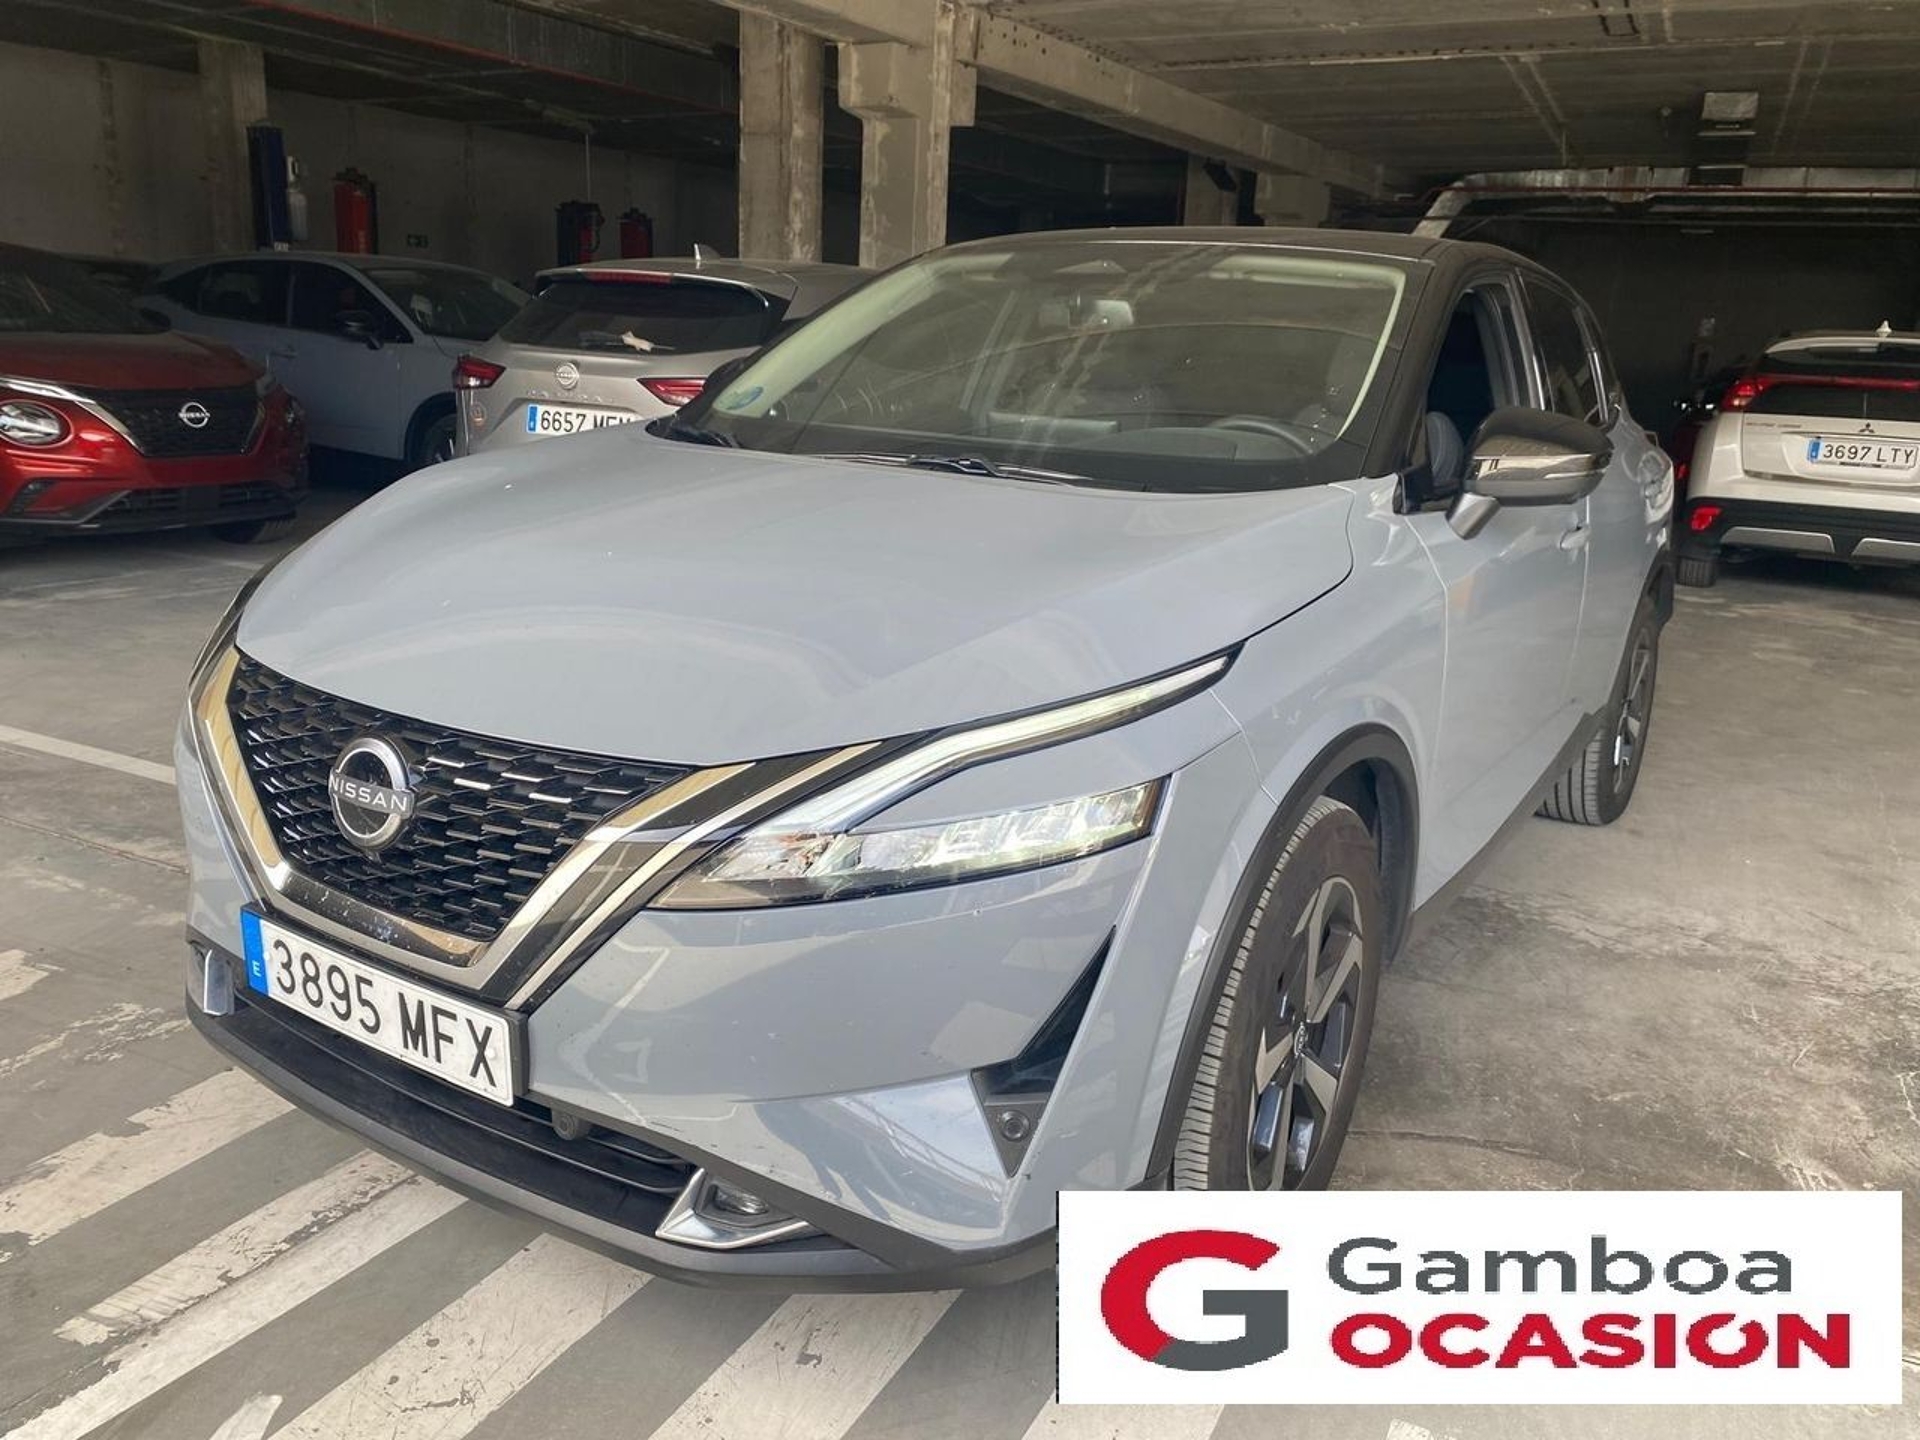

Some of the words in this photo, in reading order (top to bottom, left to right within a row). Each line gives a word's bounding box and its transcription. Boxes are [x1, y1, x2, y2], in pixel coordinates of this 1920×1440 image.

[541, 410, 587, 433] 6657
[1823, 444, 1873, 462] 3697
[1876, 447, 1915, 465] LTY
[329, 773, 408, 812] NISSAN
[251, 960, 262, 978] E
[273, 939, 382, 1035] 3895
[398, 992, 498, 1089] MFX
